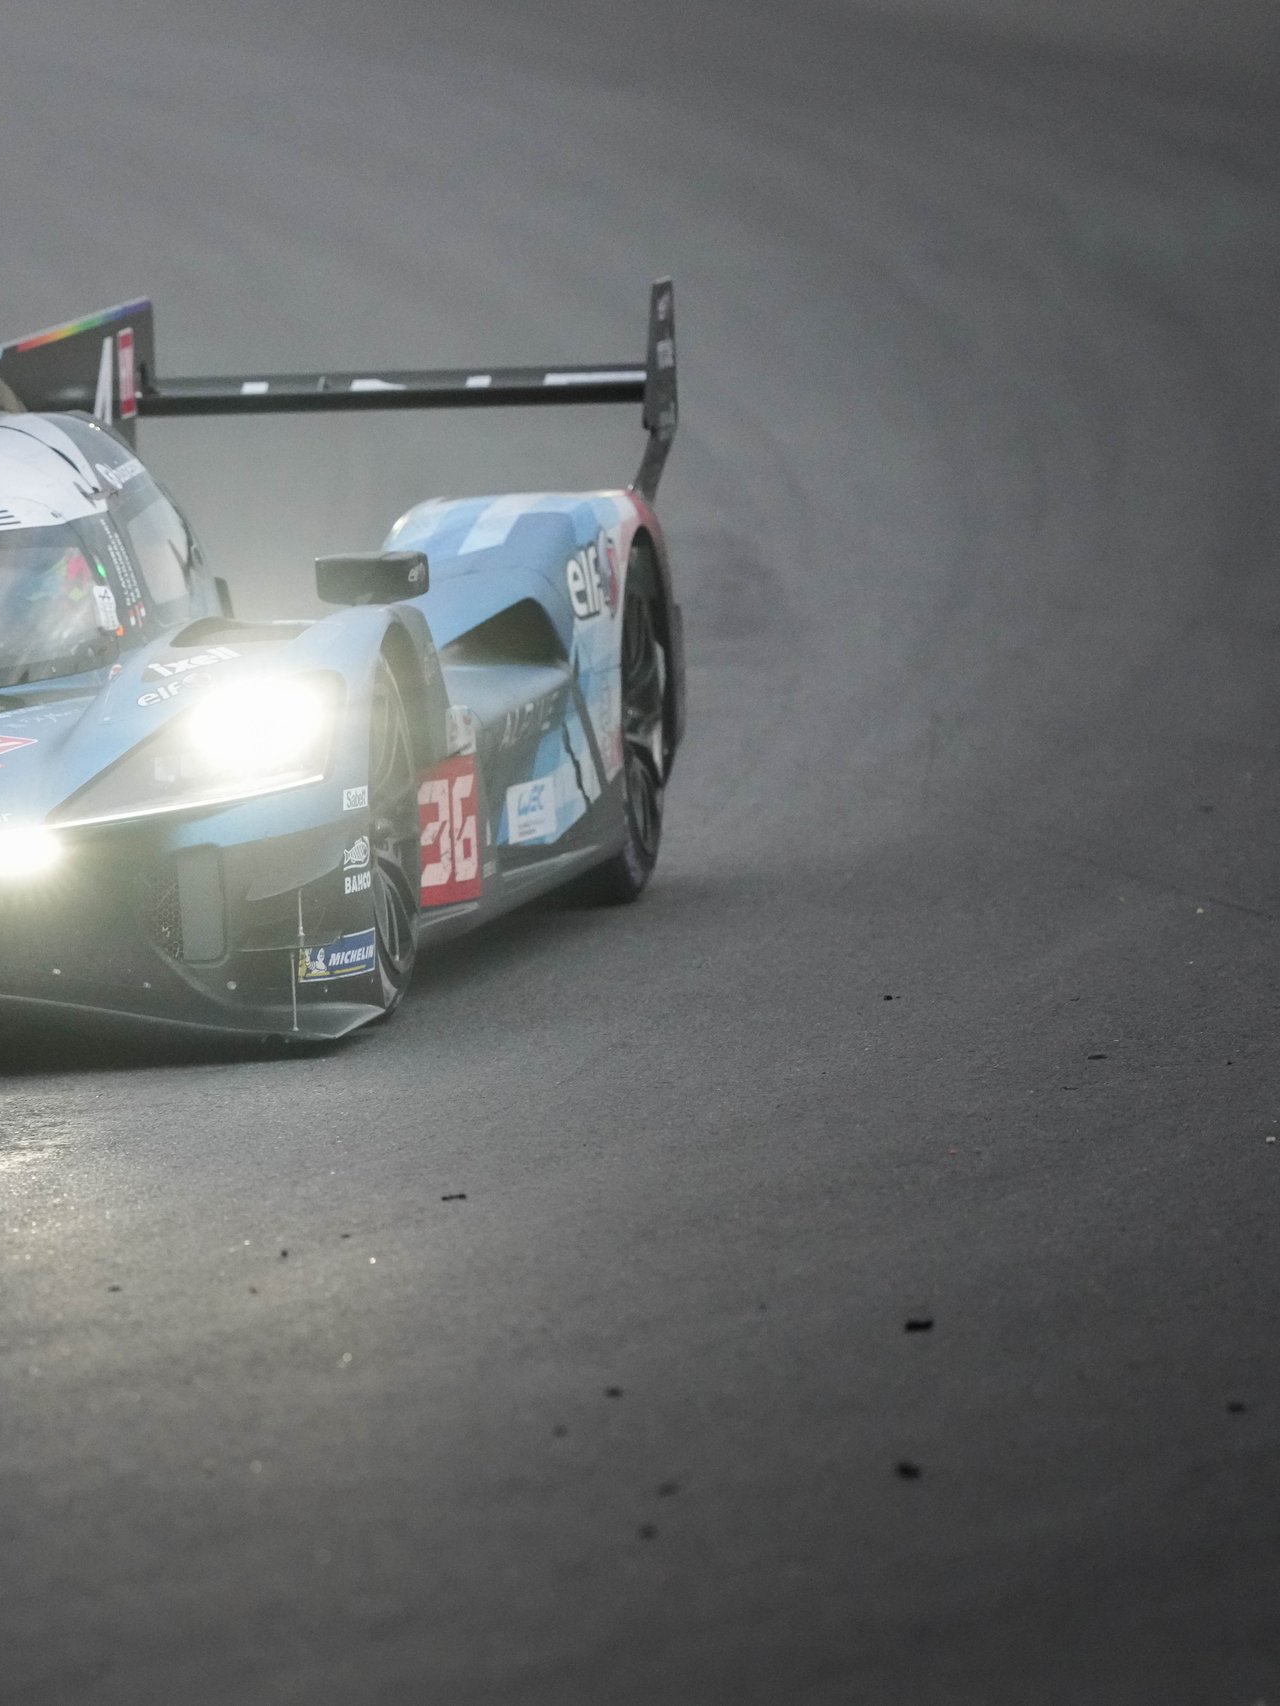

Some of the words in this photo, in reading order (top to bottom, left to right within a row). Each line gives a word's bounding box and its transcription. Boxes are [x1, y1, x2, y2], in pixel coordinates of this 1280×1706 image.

[147, 646, 242, 678] ixell
[137, 681, 182, 707] elf
[418, 773, 477, 888] 36
[344, 870, 372, 895] BAHCO
[328, 944, 376, 967] MICHELIN
